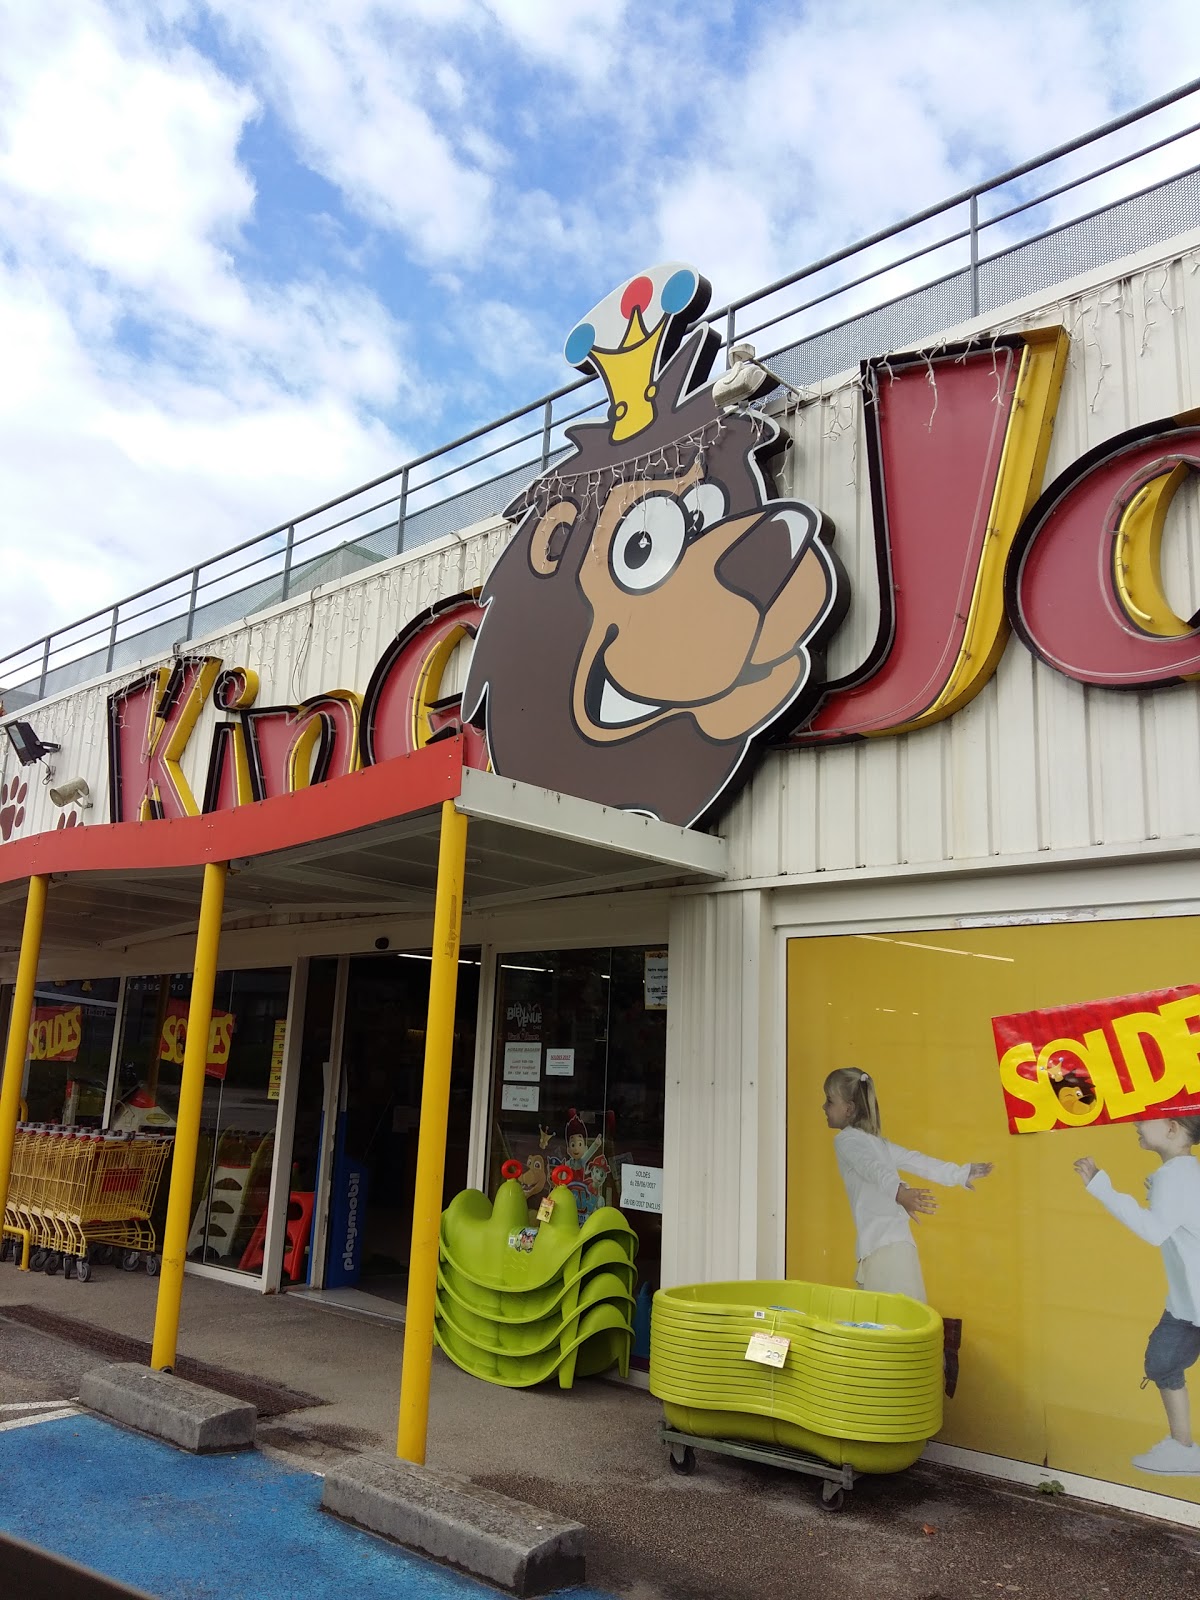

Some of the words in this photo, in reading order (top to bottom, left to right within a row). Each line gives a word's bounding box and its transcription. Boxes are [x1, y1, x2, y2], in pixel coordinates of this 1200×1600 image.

[28, 1006, 82, 1060] SOLDES
[161, 1013, 234, 1065] SOES
[635, 1170, 651, 1179] SOLDES
[342, 1172, 360, 1271] playmobil
[645, 1201, 661, 1211] INCLUS
